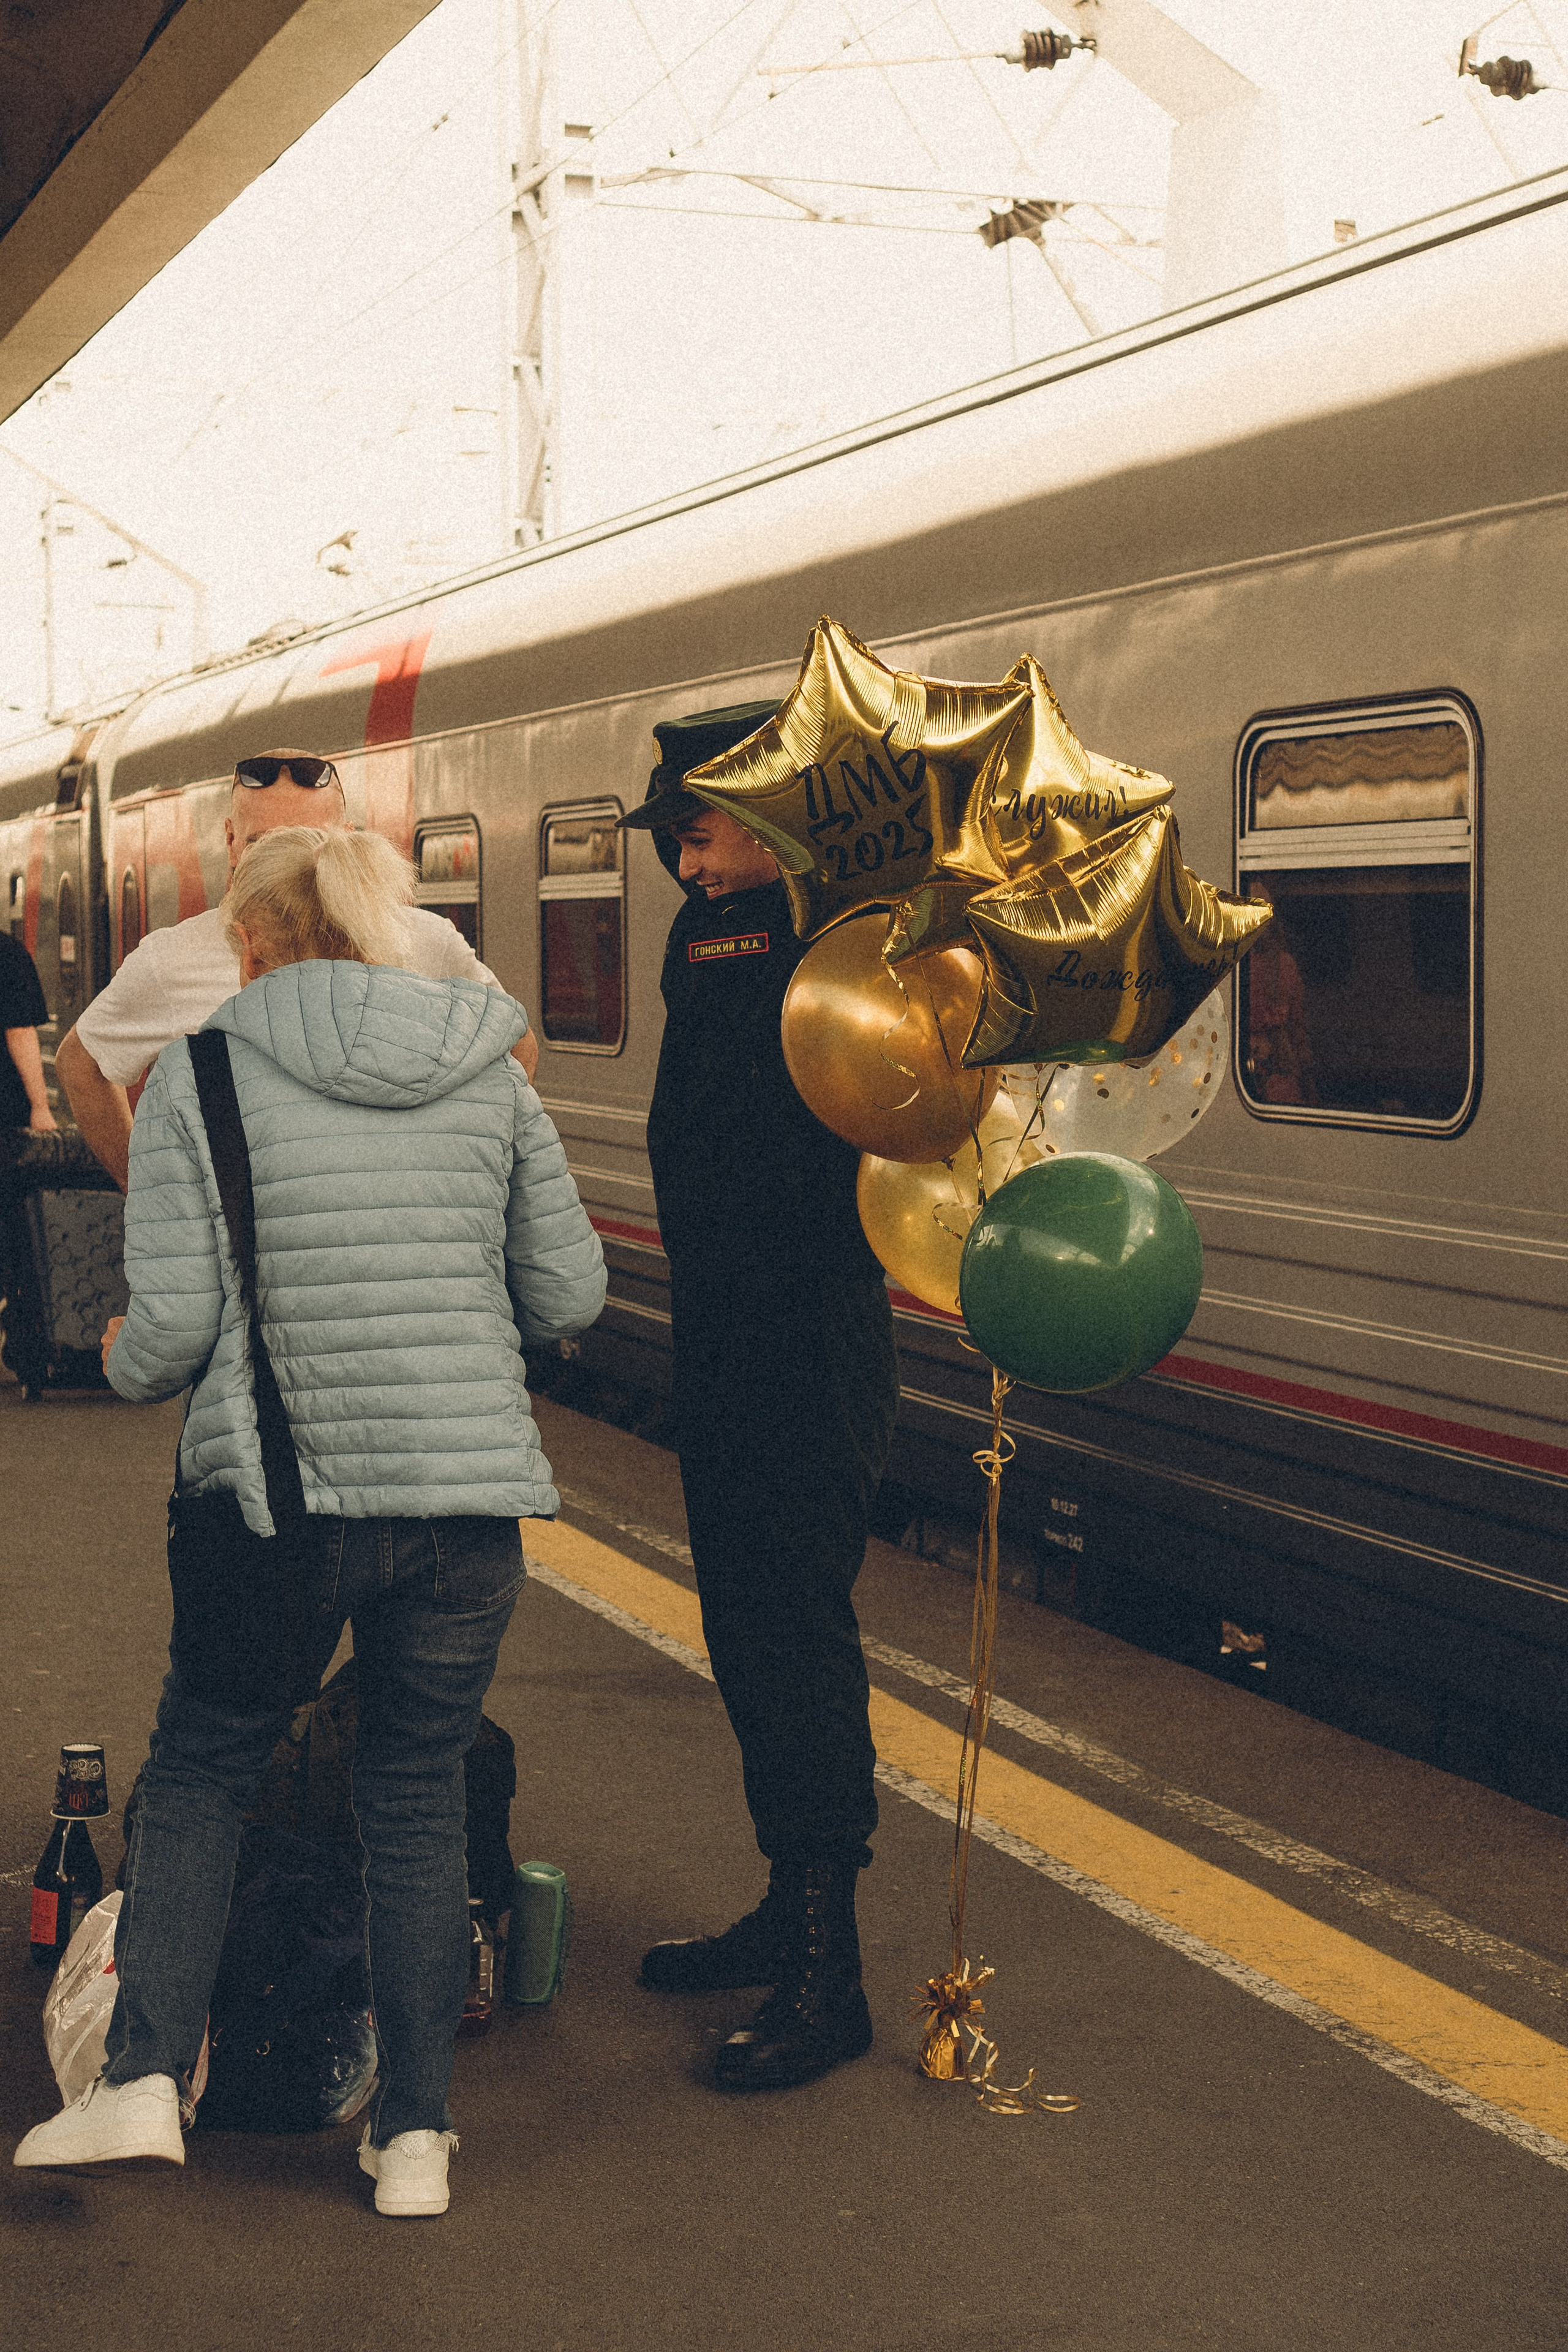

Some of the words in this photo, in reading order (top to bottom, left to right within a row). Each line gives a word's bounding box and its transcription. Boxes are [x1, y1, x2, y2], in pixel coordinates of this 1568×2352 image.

[825, 793, 934, 881] 2025
[695, 941, 735, 957] ГОНСКИЙ
[741, 939, 761, 950] М.А.
